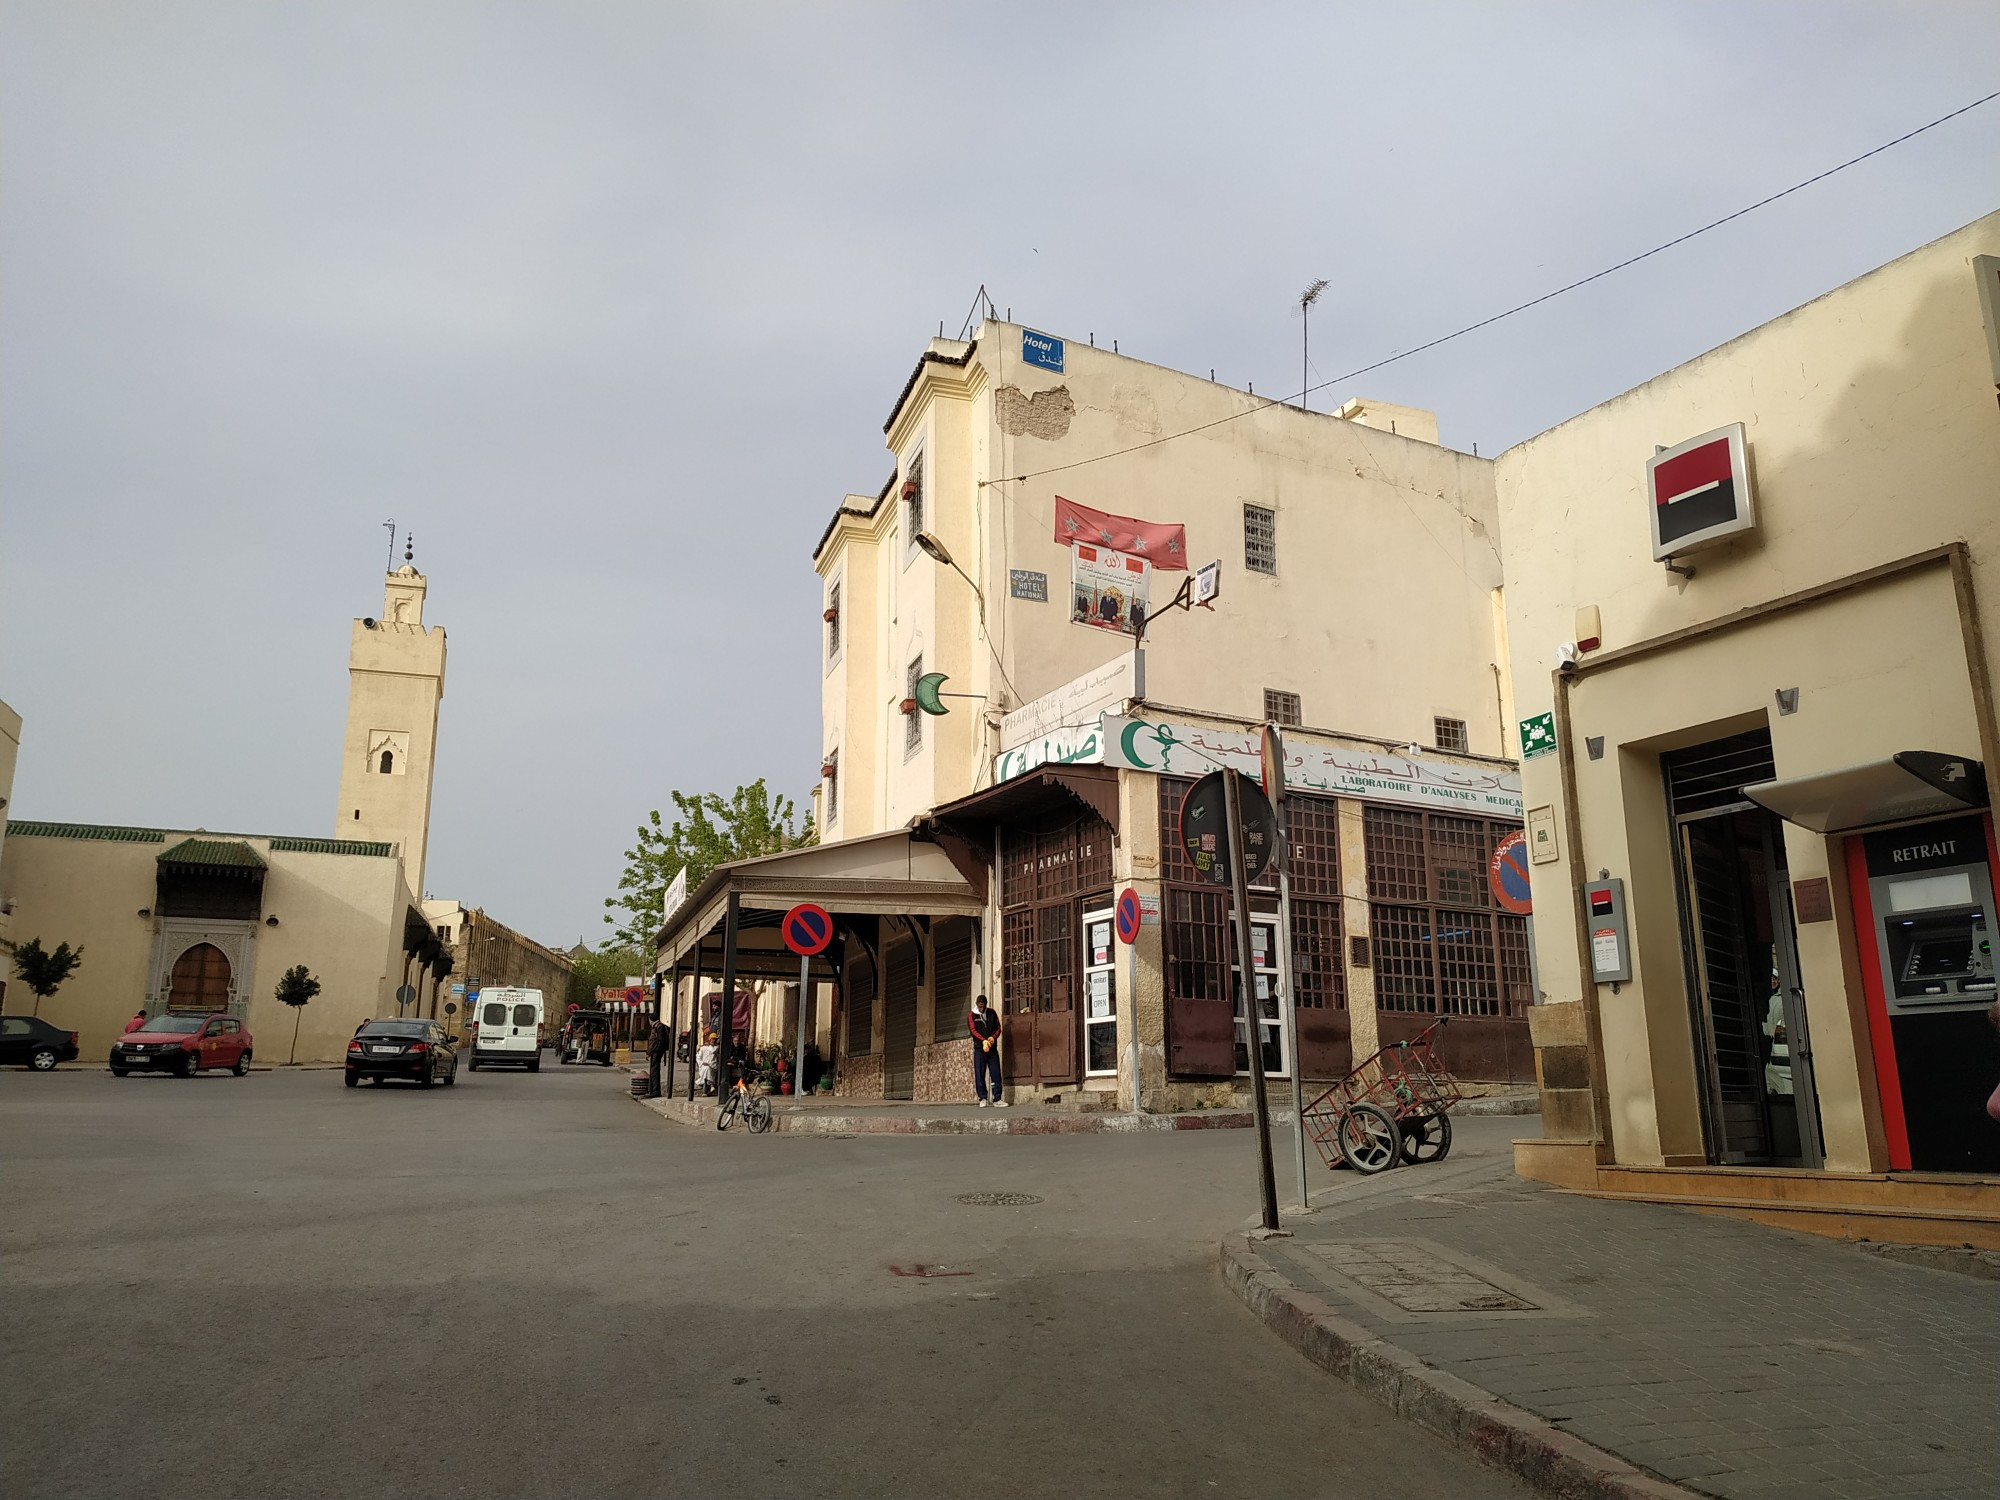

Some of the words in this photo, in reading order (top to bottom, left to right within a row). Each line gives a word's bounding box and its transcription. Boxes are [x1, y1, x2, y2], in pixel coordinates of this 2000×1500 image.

[1023, 335, 1052, 352] Hotel
[1037, 351, 1063, 366] فندق
[1016, 590, 1045, 600] NATIONAL
[1019, 582, 1042, 592] HOTEL
[1004, 694, 1057, 732] PHARMACIE
[1340, 775, 1413, 793] LABORATOIRE
[1421, 786, 1477, 802] D'ANALYSES
[1023, 845, 1092, 875] PHARMACIE
[1893, 840, 1957, 863] RETRAIT
[1093, 999, 1107, 1008] OPEN
